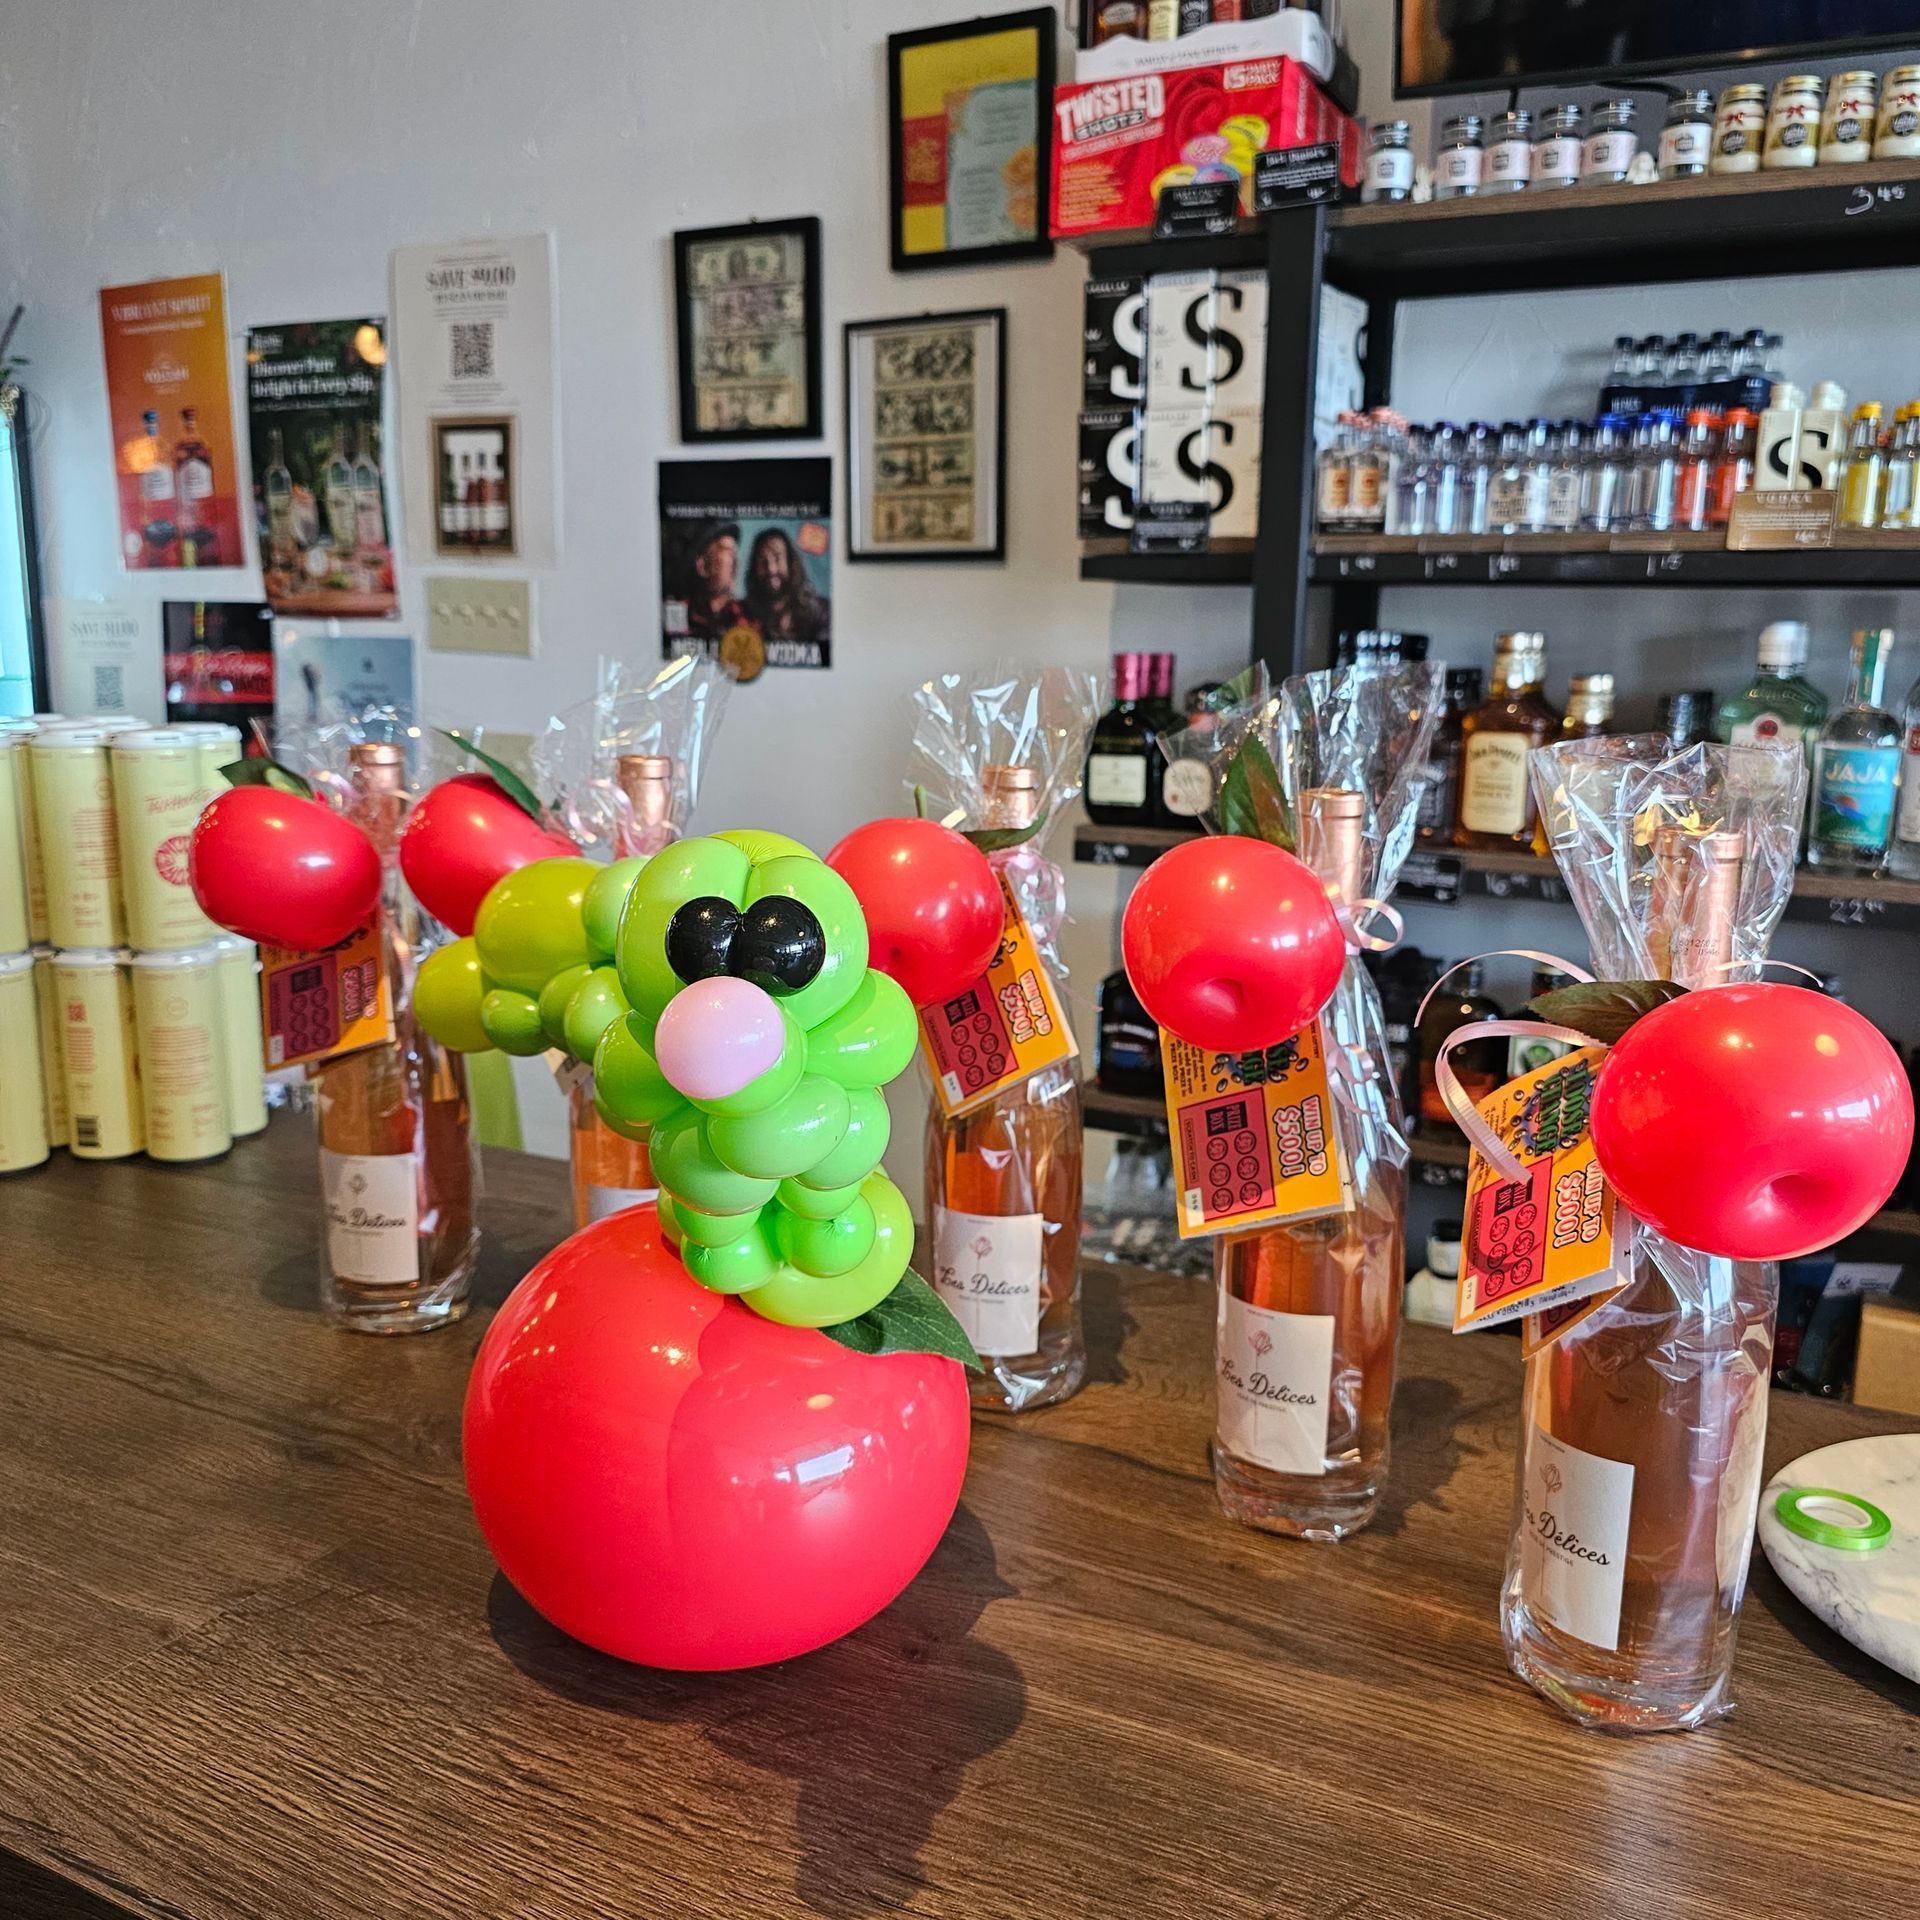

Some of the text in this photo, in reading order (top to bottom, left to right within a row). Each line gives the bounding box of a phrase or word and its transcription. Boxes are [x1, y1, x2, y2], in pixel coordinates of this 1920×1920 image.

[1074, 111, 1145, 142] SHOTZ
[1180, 286, 1244, 393] S
[1824, 761, 1888, 785] JAJA
[1020, 970, 1053, 1036] WIN UP TO
[1209, 1111, 1225, 1131] BOX
[1226, 1103, 1241, 1130] PRIZE
[1534, 1075, 1562, 1157] CHANGE
[1560, 1069, 1589, 1136] LOOSE
[1273, 1106, 1305, 1177] $500!
[1302, 1095, 1327, 1175] WIN UP TO
[1497, 1188, 1513, 1210] BOX
[1552, 1170, 1585, 1249] $500!
[1580, 1159, 1603, 1243] WIN UP TO
[939, 1265, 965, 1291] Les
[1221, 1356, 1244, 1388] Les
[1247, 1371, 1317, 1405] Délices
[1537, 1511, 1611, 1566] Délices
